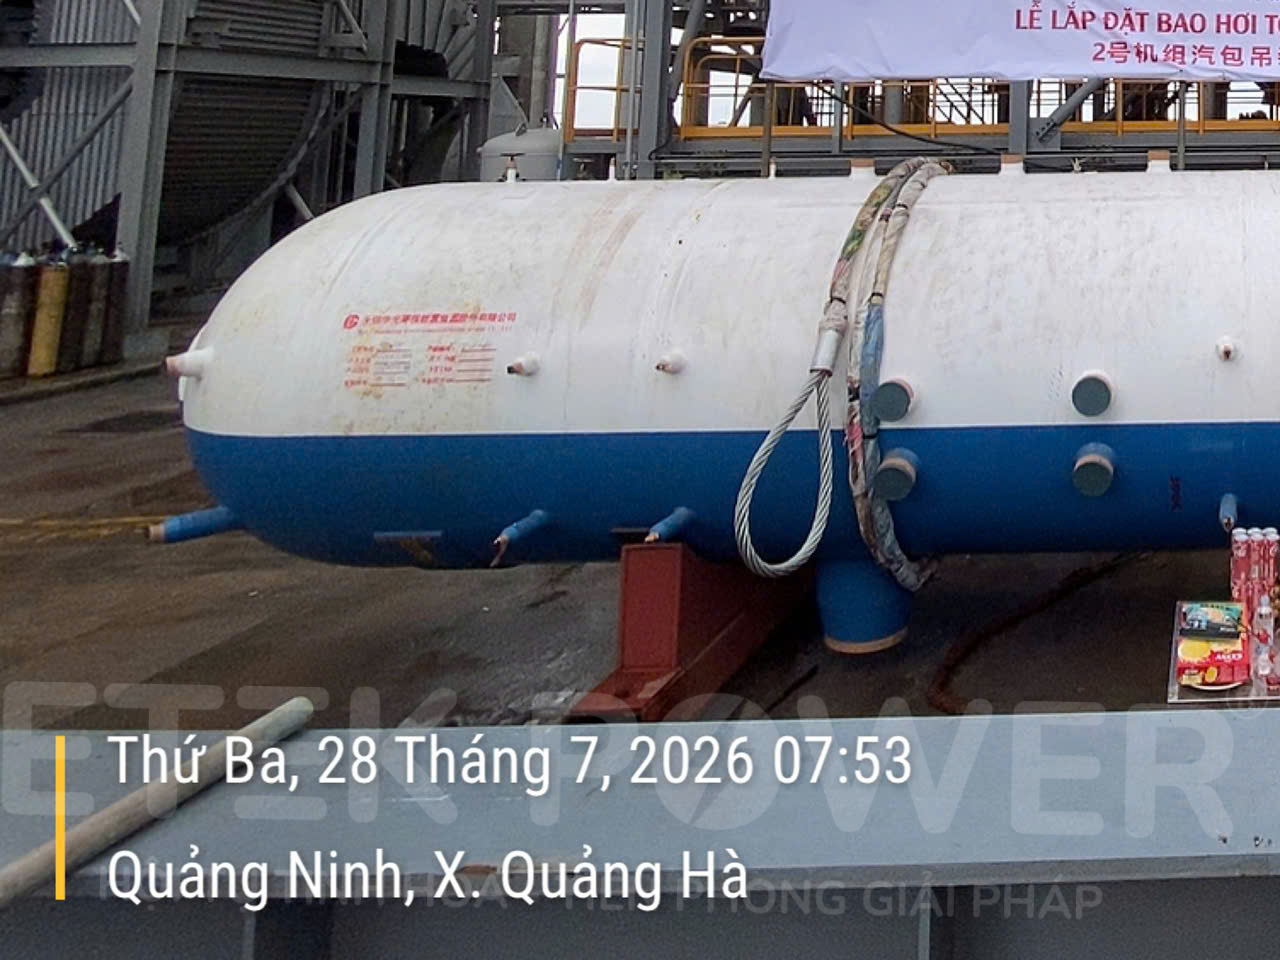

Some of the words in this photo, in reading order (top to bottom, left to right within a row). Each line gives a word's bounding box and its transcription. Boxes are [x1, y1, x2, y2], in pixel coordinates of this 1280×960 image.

[1015, 0, 1043, 30] LỄ
[1051, 1, 1096, 30] LẮP
[1103, 5, 1149, 36] ĐẶT
[1157, 12, 1206, 33] BAO
[1216, 12, 1257, 35] HƠI
